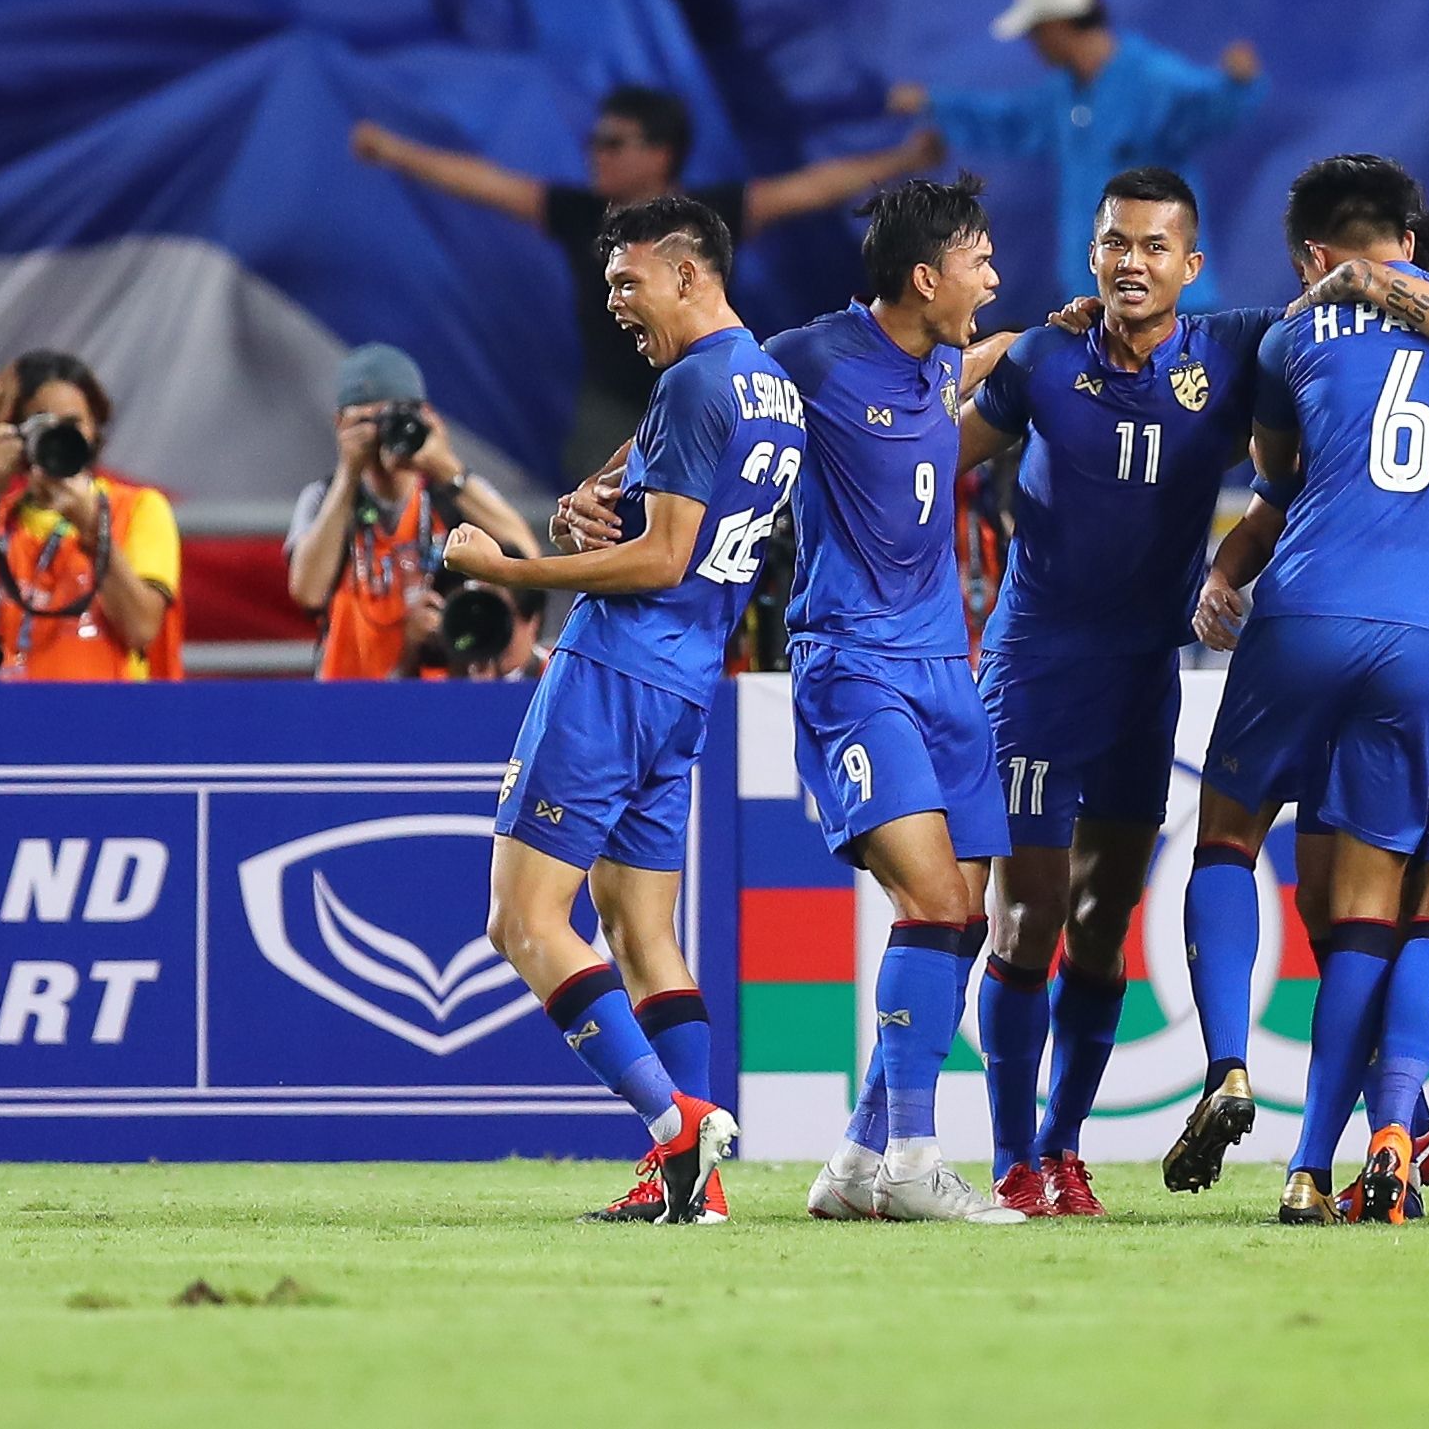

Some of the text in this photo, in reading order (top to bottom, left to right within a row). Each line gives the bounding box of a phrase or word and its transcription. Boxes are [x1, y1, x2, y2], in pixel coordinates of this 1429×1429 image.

[1314, 302, 1419, 344] H.PA
[1115, 421, 1162, 484] 11
[914, 462, 936, 525] 9
[842, 743, 872, 803] 9
[1008, 756, 1050, 815] 11
